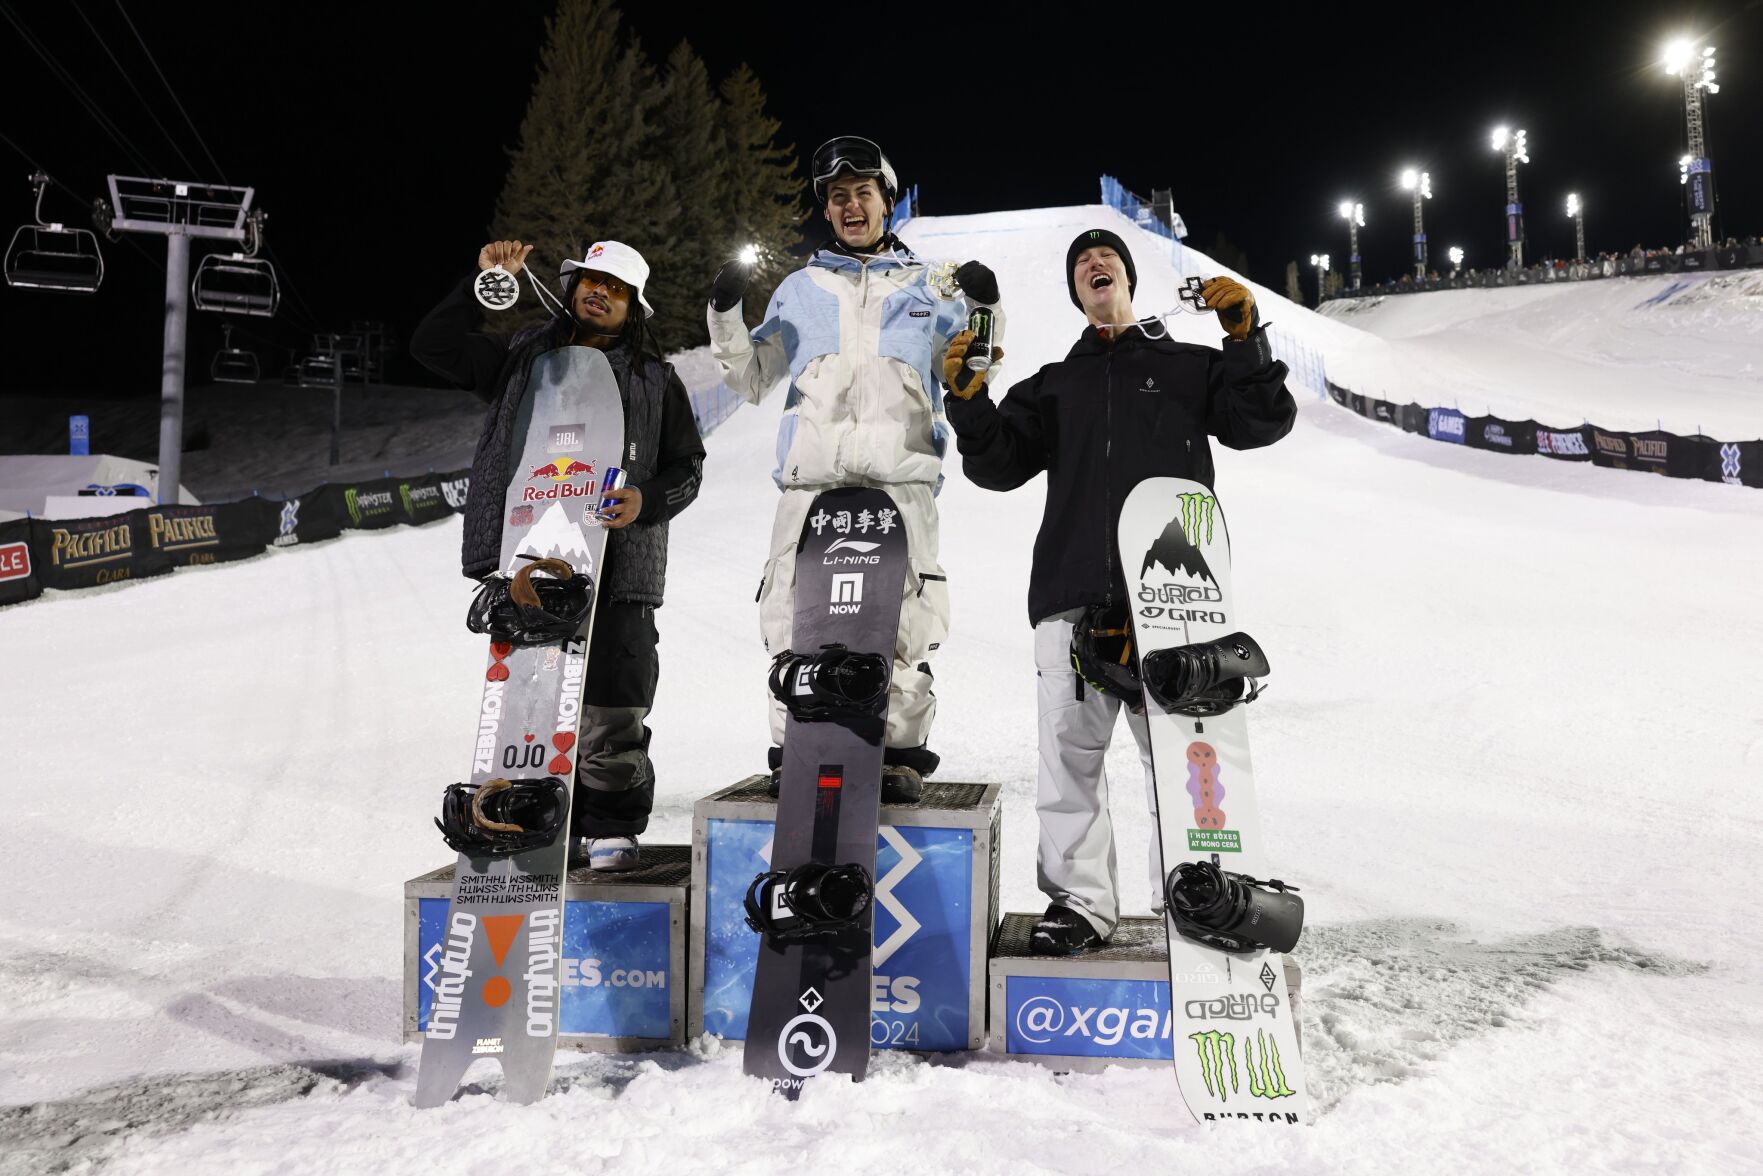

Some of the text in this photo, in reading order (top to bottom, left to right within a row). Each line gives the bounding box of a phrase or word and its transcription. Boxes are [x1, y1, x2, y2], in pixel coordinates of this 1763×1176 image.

[556, 432, 579, 446] JBL
[1630, 437, 1667, 457] PACIFICO
[356, 491, 392, 509] MONSTER
[523, 481, 595, 501] Red Bull
[149, 513, 216, 548] PACIFICO
[810, 508, 897, 535] 中國李寧
[52, 524, 131, 566] PACIFICO
[823, 555, 880, 565] LI-NING
[829, 604, 861, 614] NOW
[1168, 608, 1226, 624] GIRO
[556, 640, 586, 732] ZEBULON
[472, 682, 505, 774] ZEBULON
[503, 744, 546, 769] OJO
[457, 894, 558, 904] SMITH SMITH SMITH
[1016, 996, 1172, 1046] @xga
